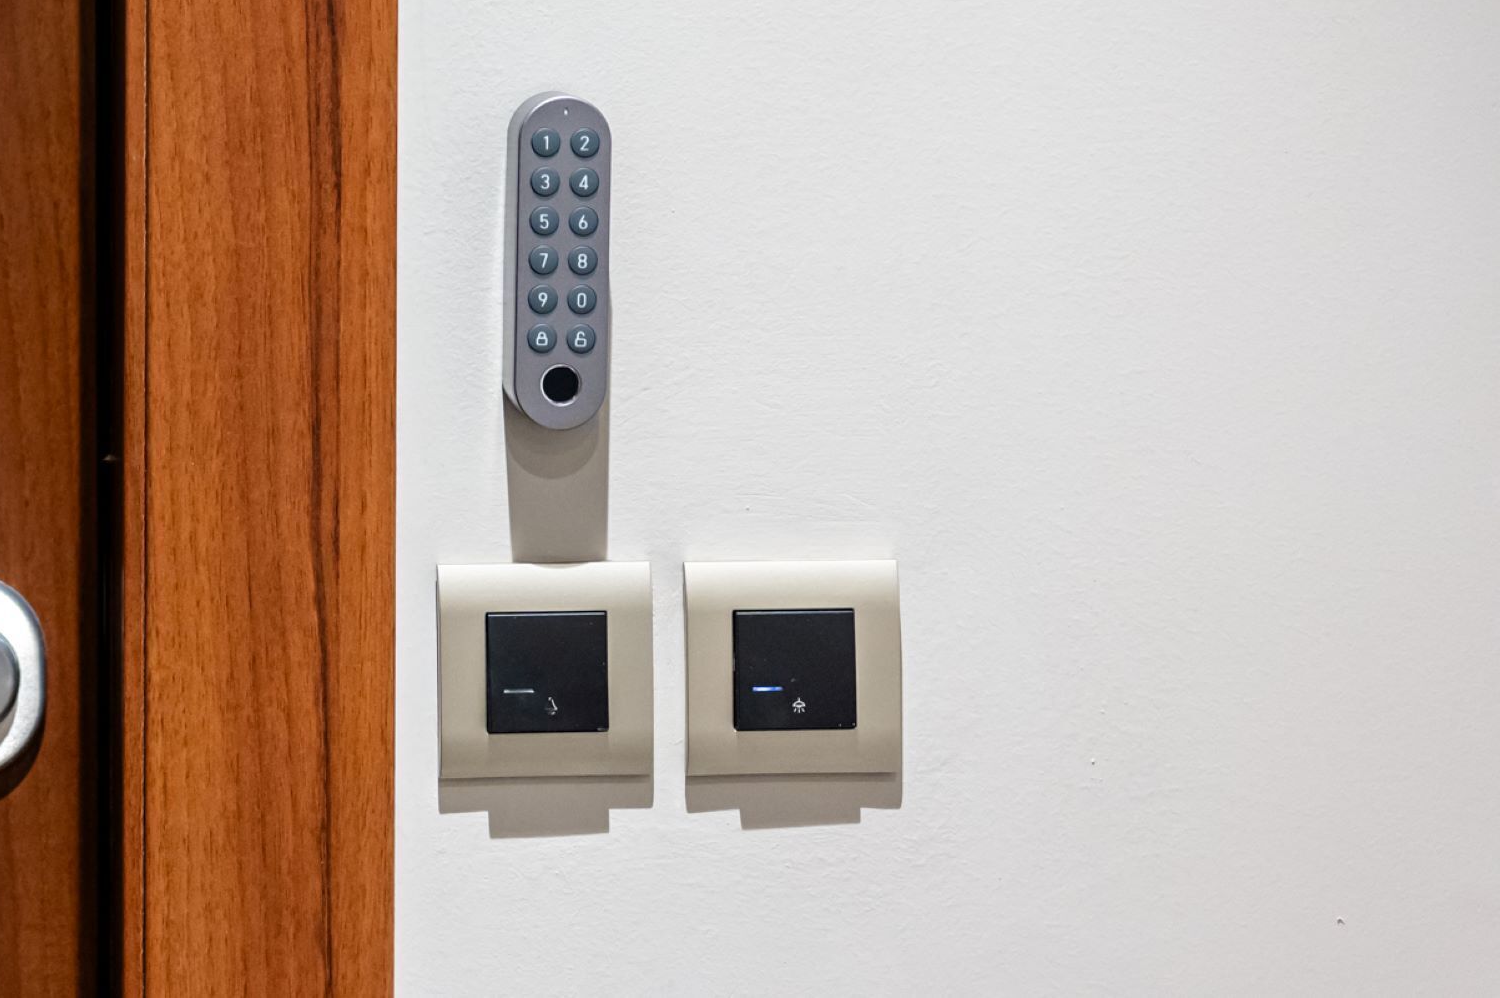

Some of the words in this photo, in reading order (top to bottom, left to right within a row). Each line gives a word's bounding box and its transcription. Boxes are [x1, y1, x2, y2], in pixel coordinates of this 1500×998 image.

[580, 135, 590, 152] 2
[541, 173, 550, 190] 3
[578, 174, 589, 190] 4
[539, 213, 549, 230] 5
[578, 214, 589, 230] 6
[539, 252, 549, 268] 7
[577, 253, 588, 269] 8
[538, 291, 548, 307] 9
[576, 292, 587, 308] 0
